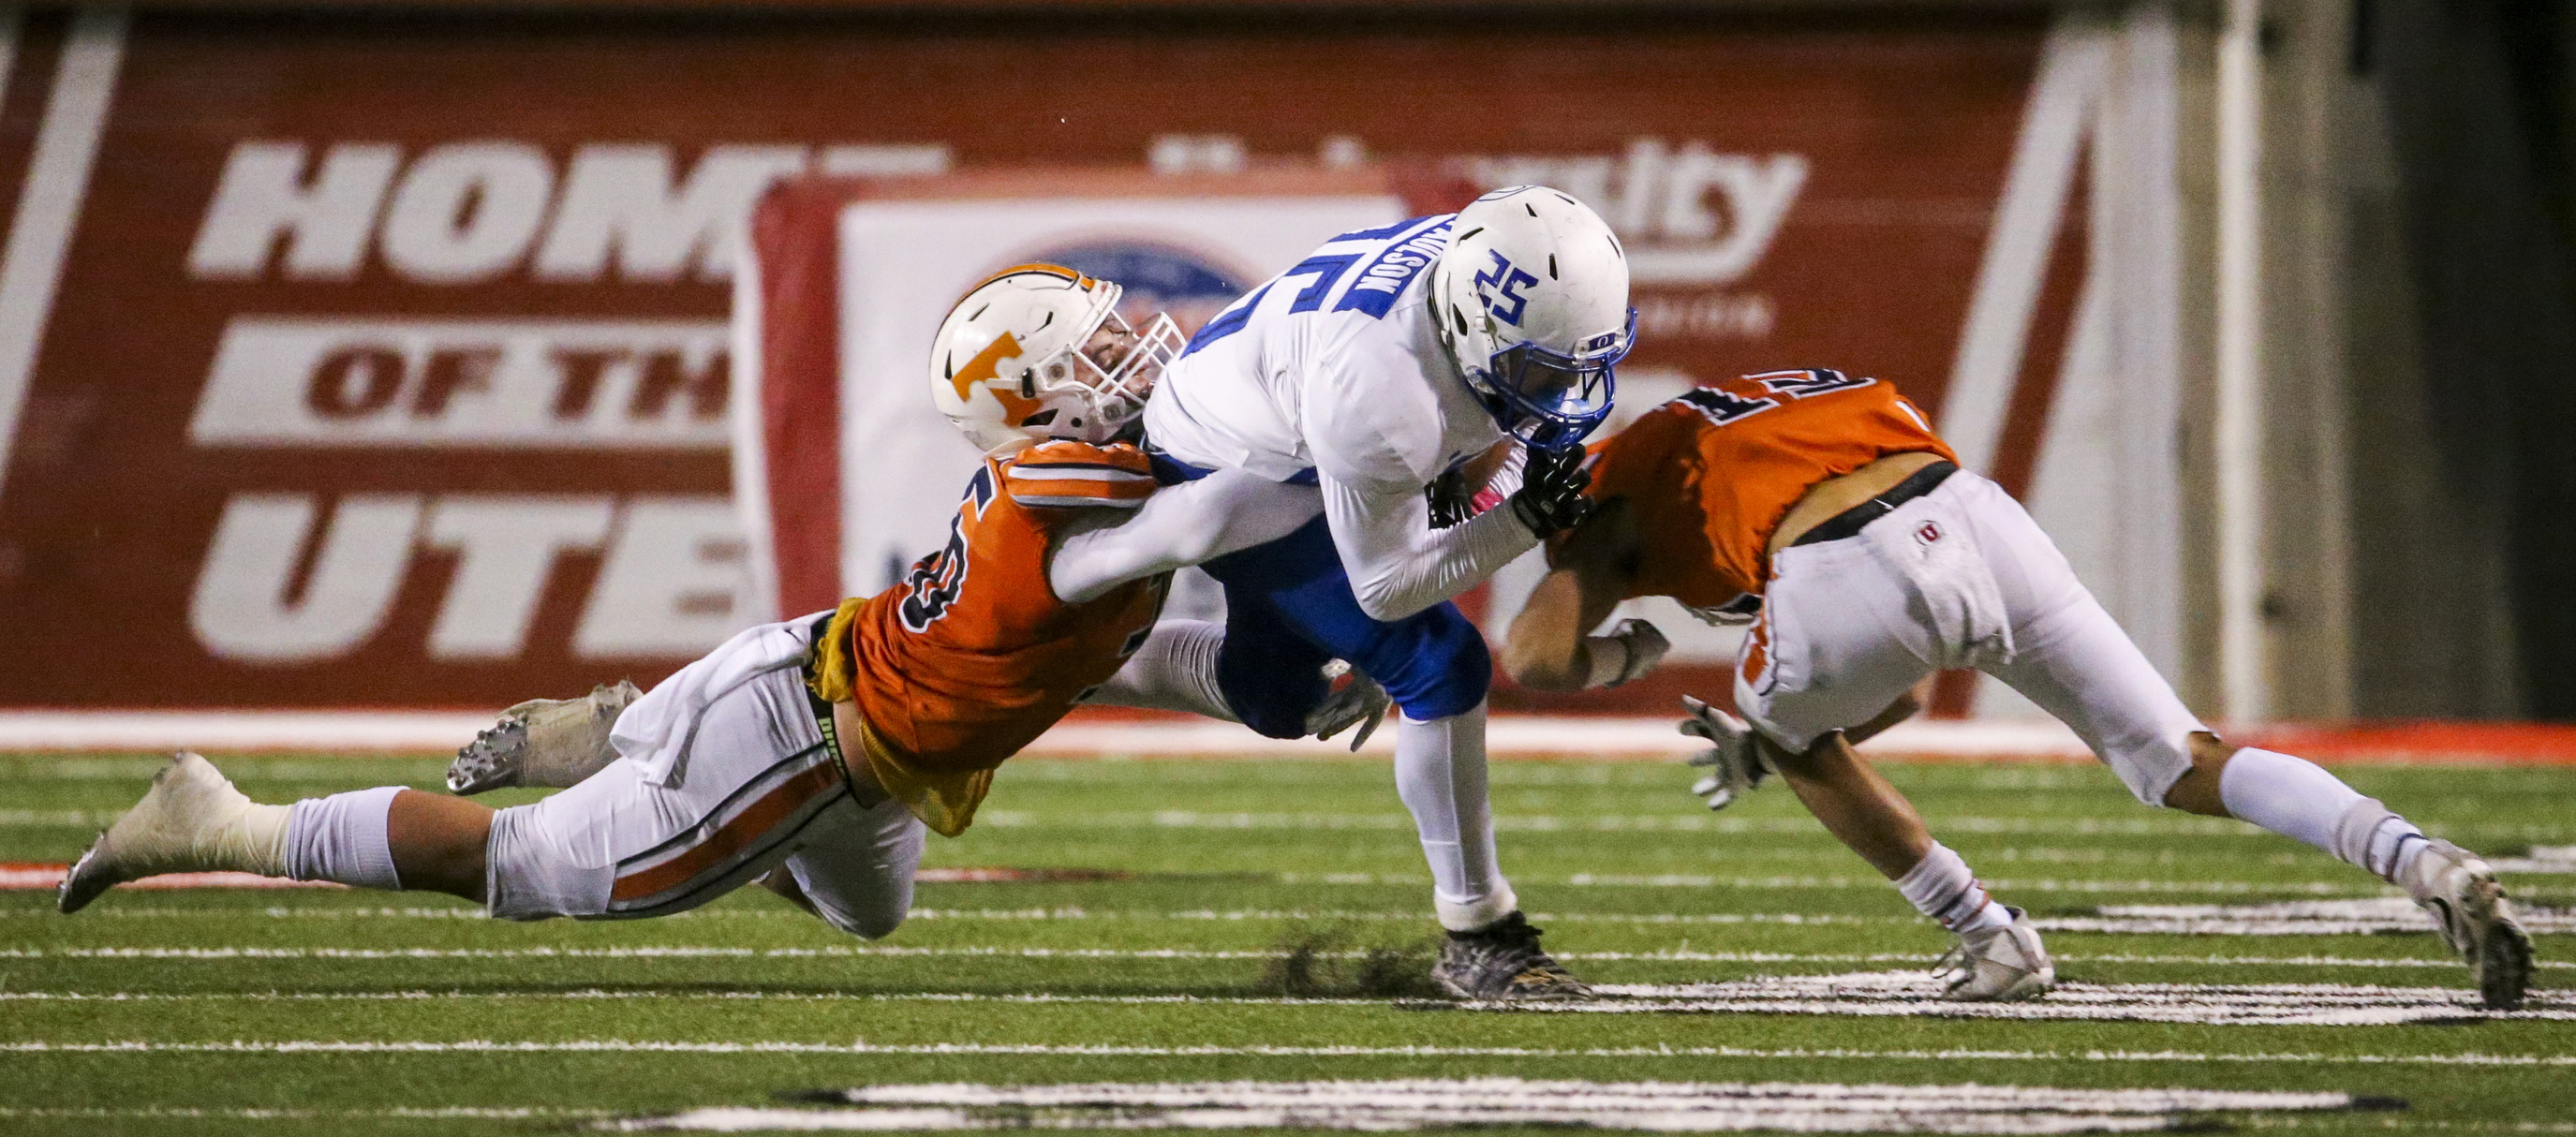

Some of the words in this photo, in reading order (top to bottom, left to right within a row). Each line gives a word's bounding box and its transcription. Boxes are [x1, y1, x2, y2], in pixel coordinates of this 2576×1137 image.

[187, 140, 950, 284] HOM
[1354, 219, 1458, 295] AULSON
[1473, 248, 1539, 327] 25
[304, 345, 502, 421] OF
[540, 345, 731, 421] TH
[187, 491, 755, 663] UTE
